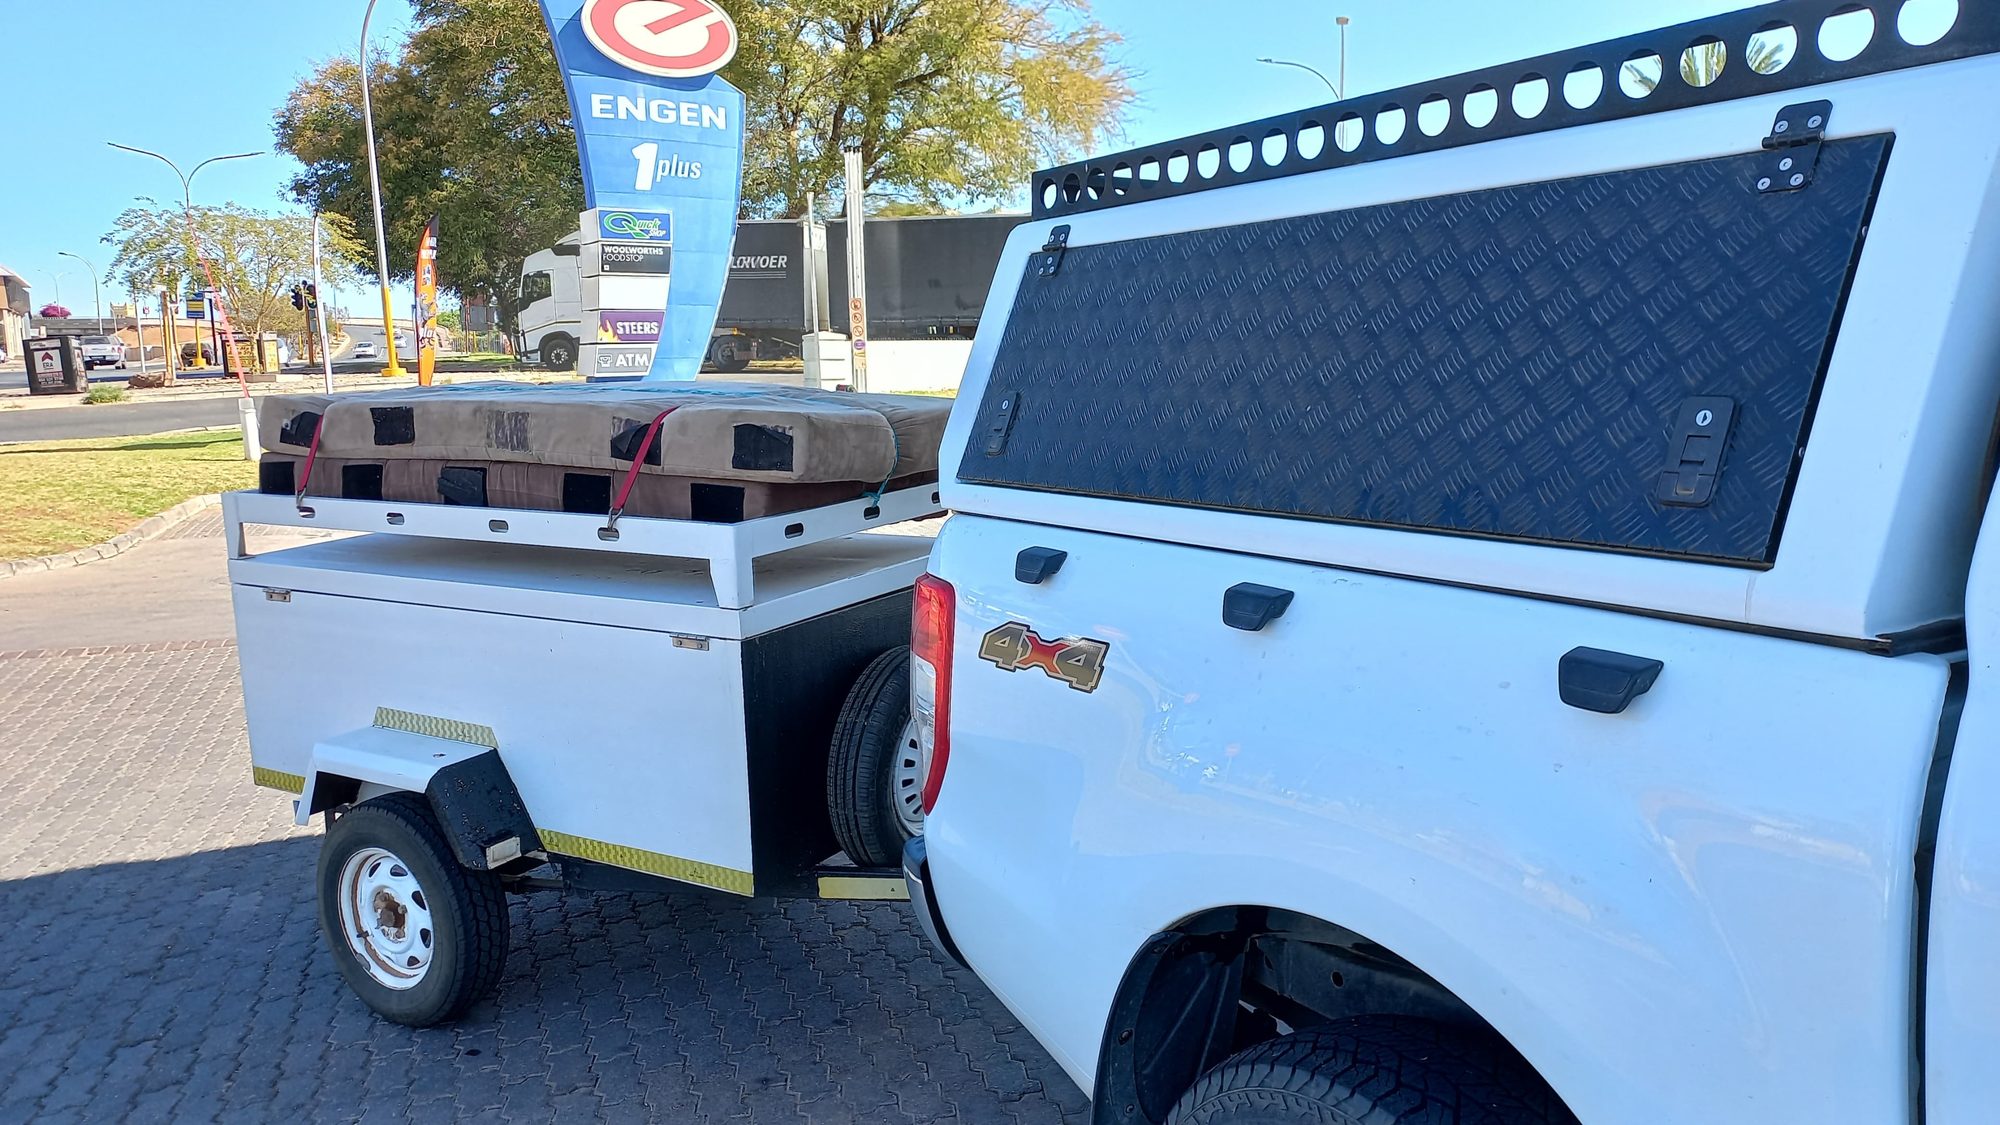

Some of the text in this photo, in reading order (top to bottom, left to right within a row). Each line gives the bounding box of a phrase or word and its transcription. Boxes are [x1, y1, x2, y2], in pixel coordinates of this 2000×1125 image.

[591, 93, 727, 130] ENGEN
[603, 246, 664, 255] WOOLWORTHS
[616, 321, 659, 335] STEERS
[615, 353, 649, 367] ATM
